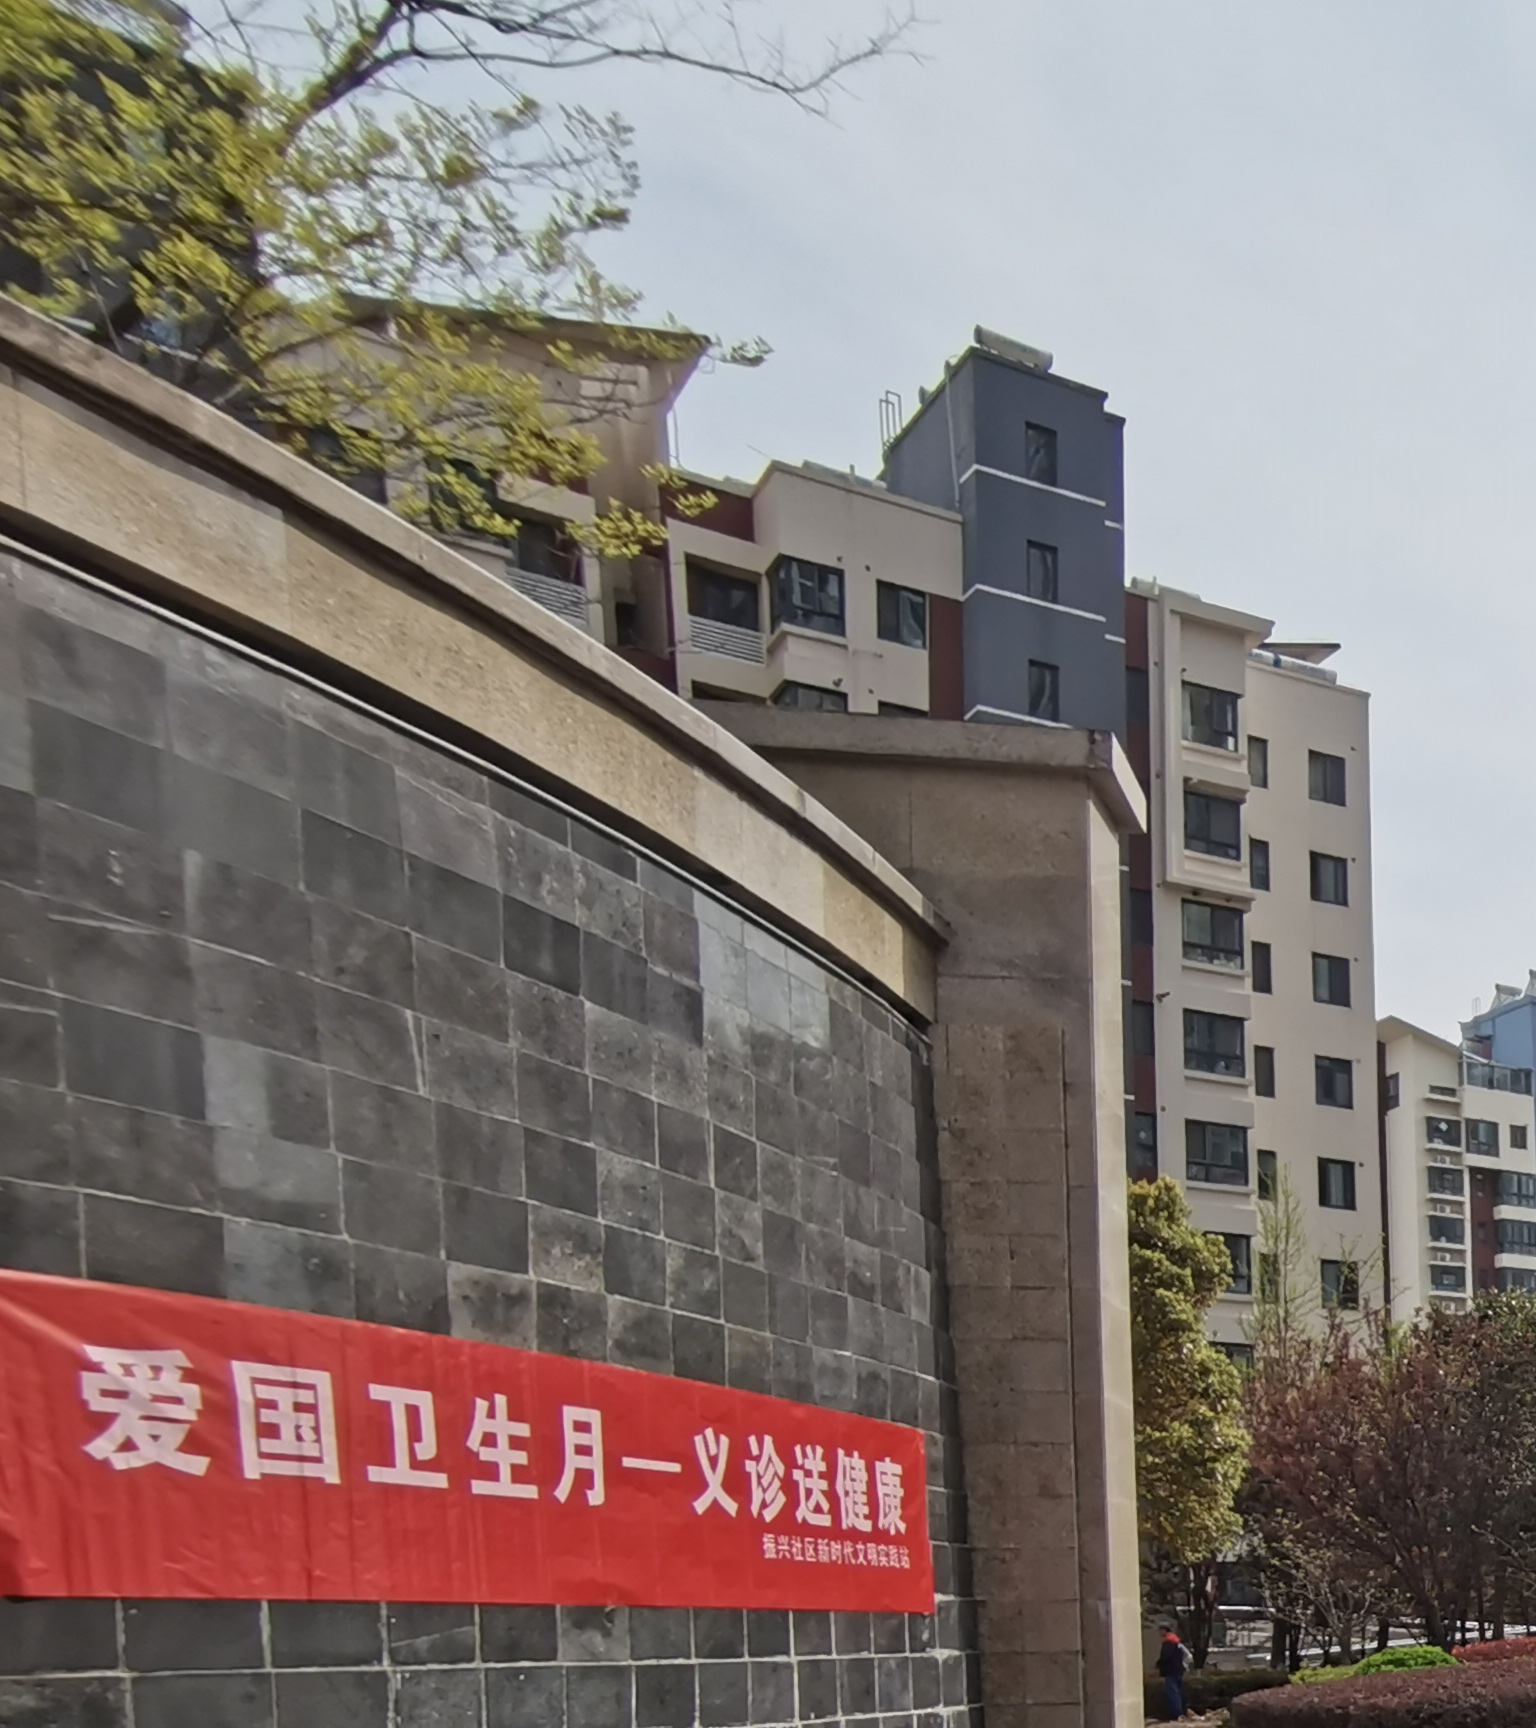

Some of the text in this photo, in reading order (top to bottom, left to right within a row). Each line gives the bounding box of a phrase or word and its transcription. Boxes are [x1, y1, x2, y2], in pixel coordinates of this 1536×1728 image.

[763, 1532, 911, 1569] 振兴社区新时代文明实践站
